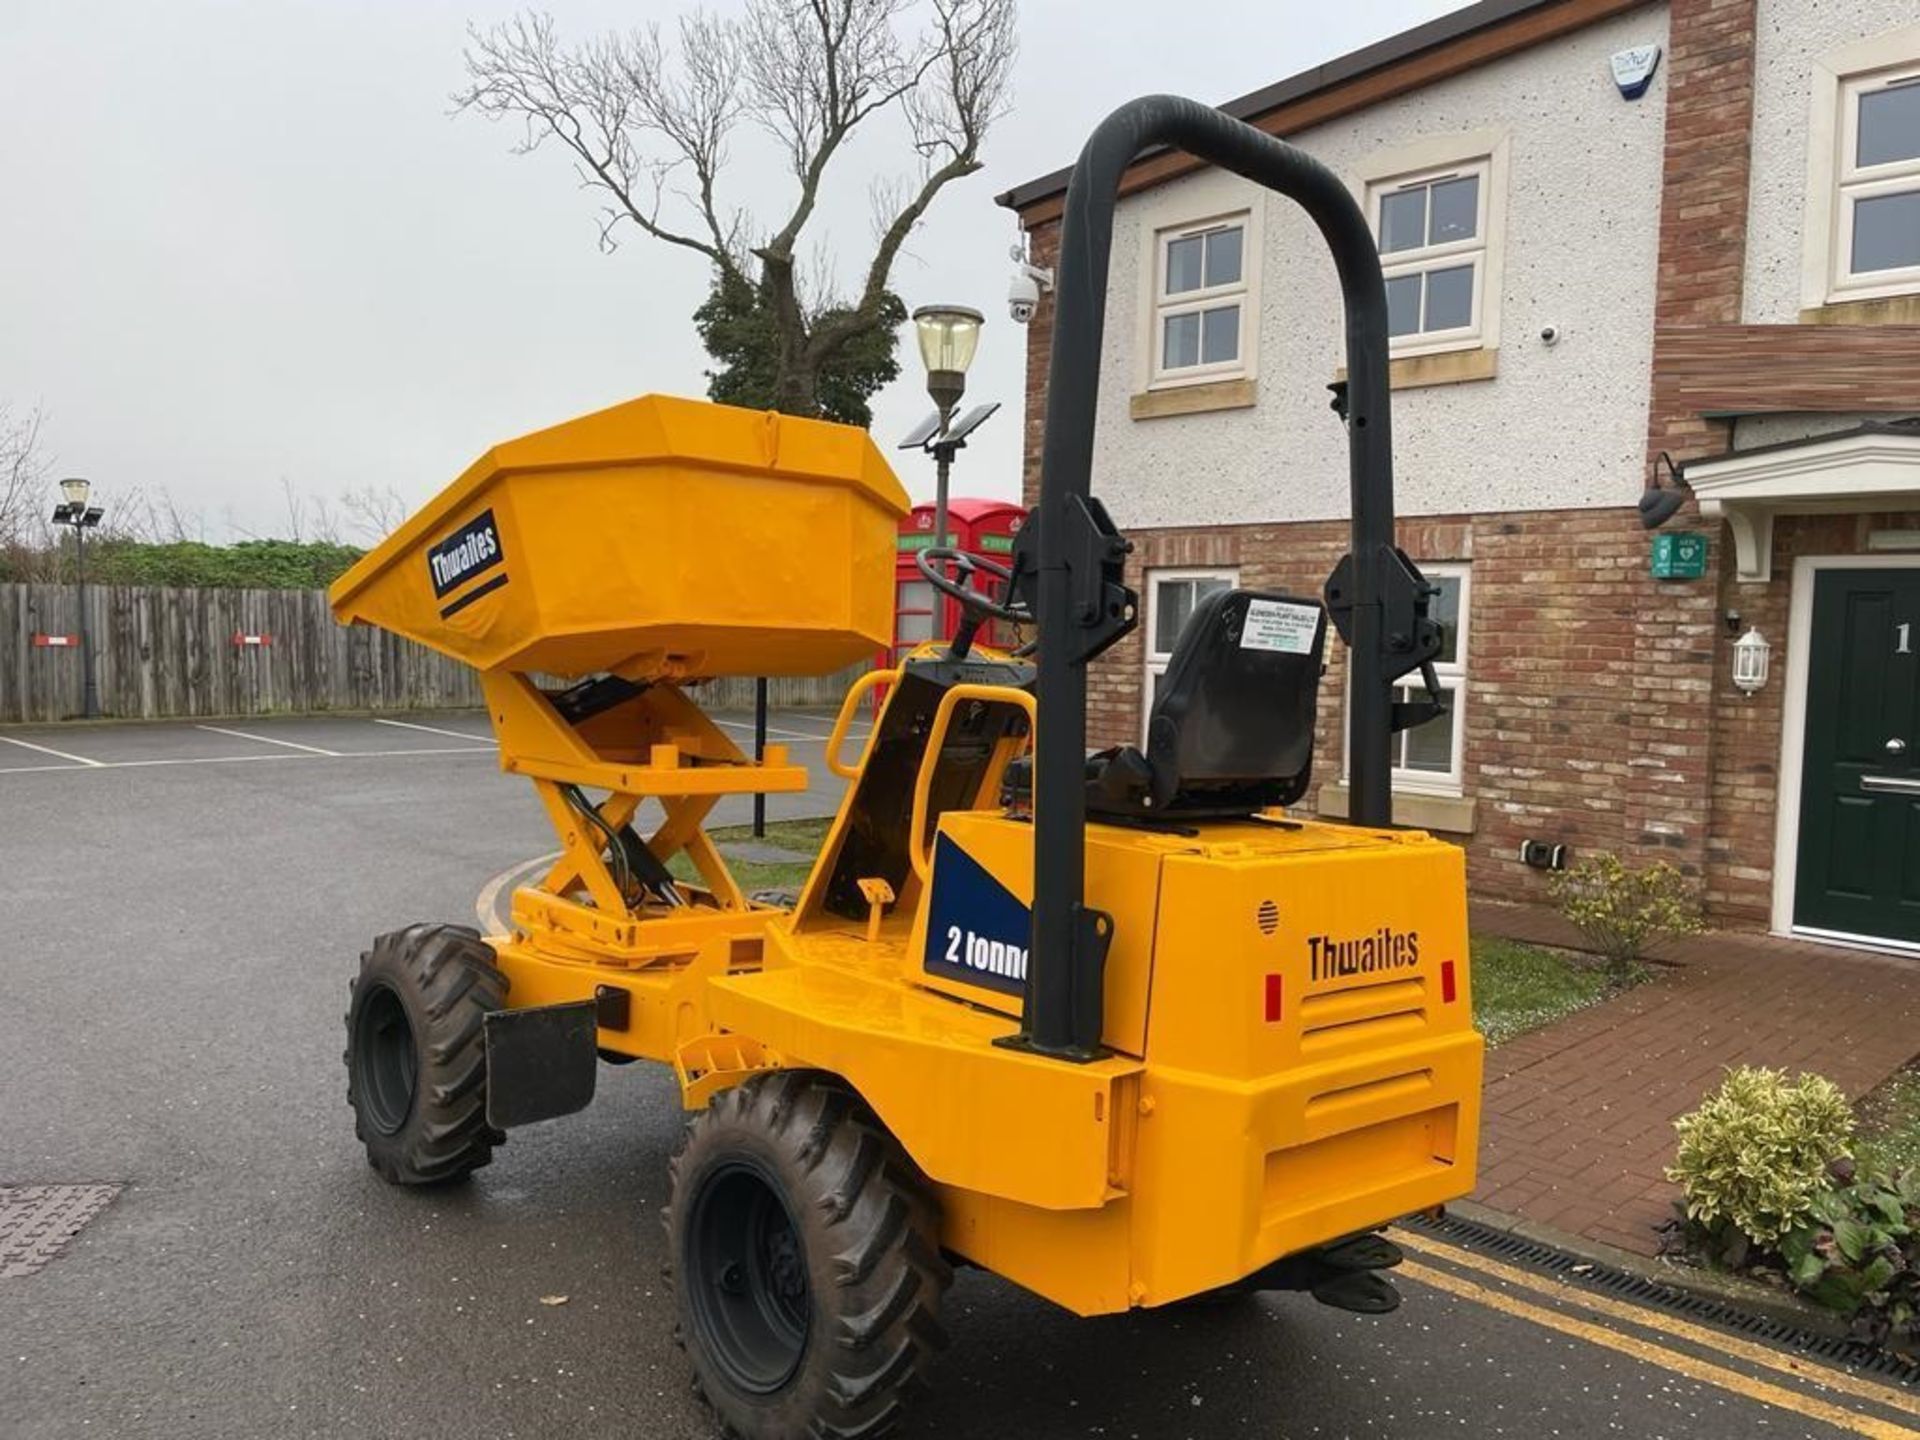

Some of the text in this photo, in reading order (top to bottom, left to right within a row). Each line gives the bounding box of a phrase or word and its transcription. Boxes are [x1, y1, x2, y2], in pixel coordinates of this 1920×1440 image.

[432, 527, 497, 587] Thwaites
[1896, 623, 1911, 653] 1
[945, 925, 962, 963] 2
[1307, 927, 1418, 981] Thwaites
